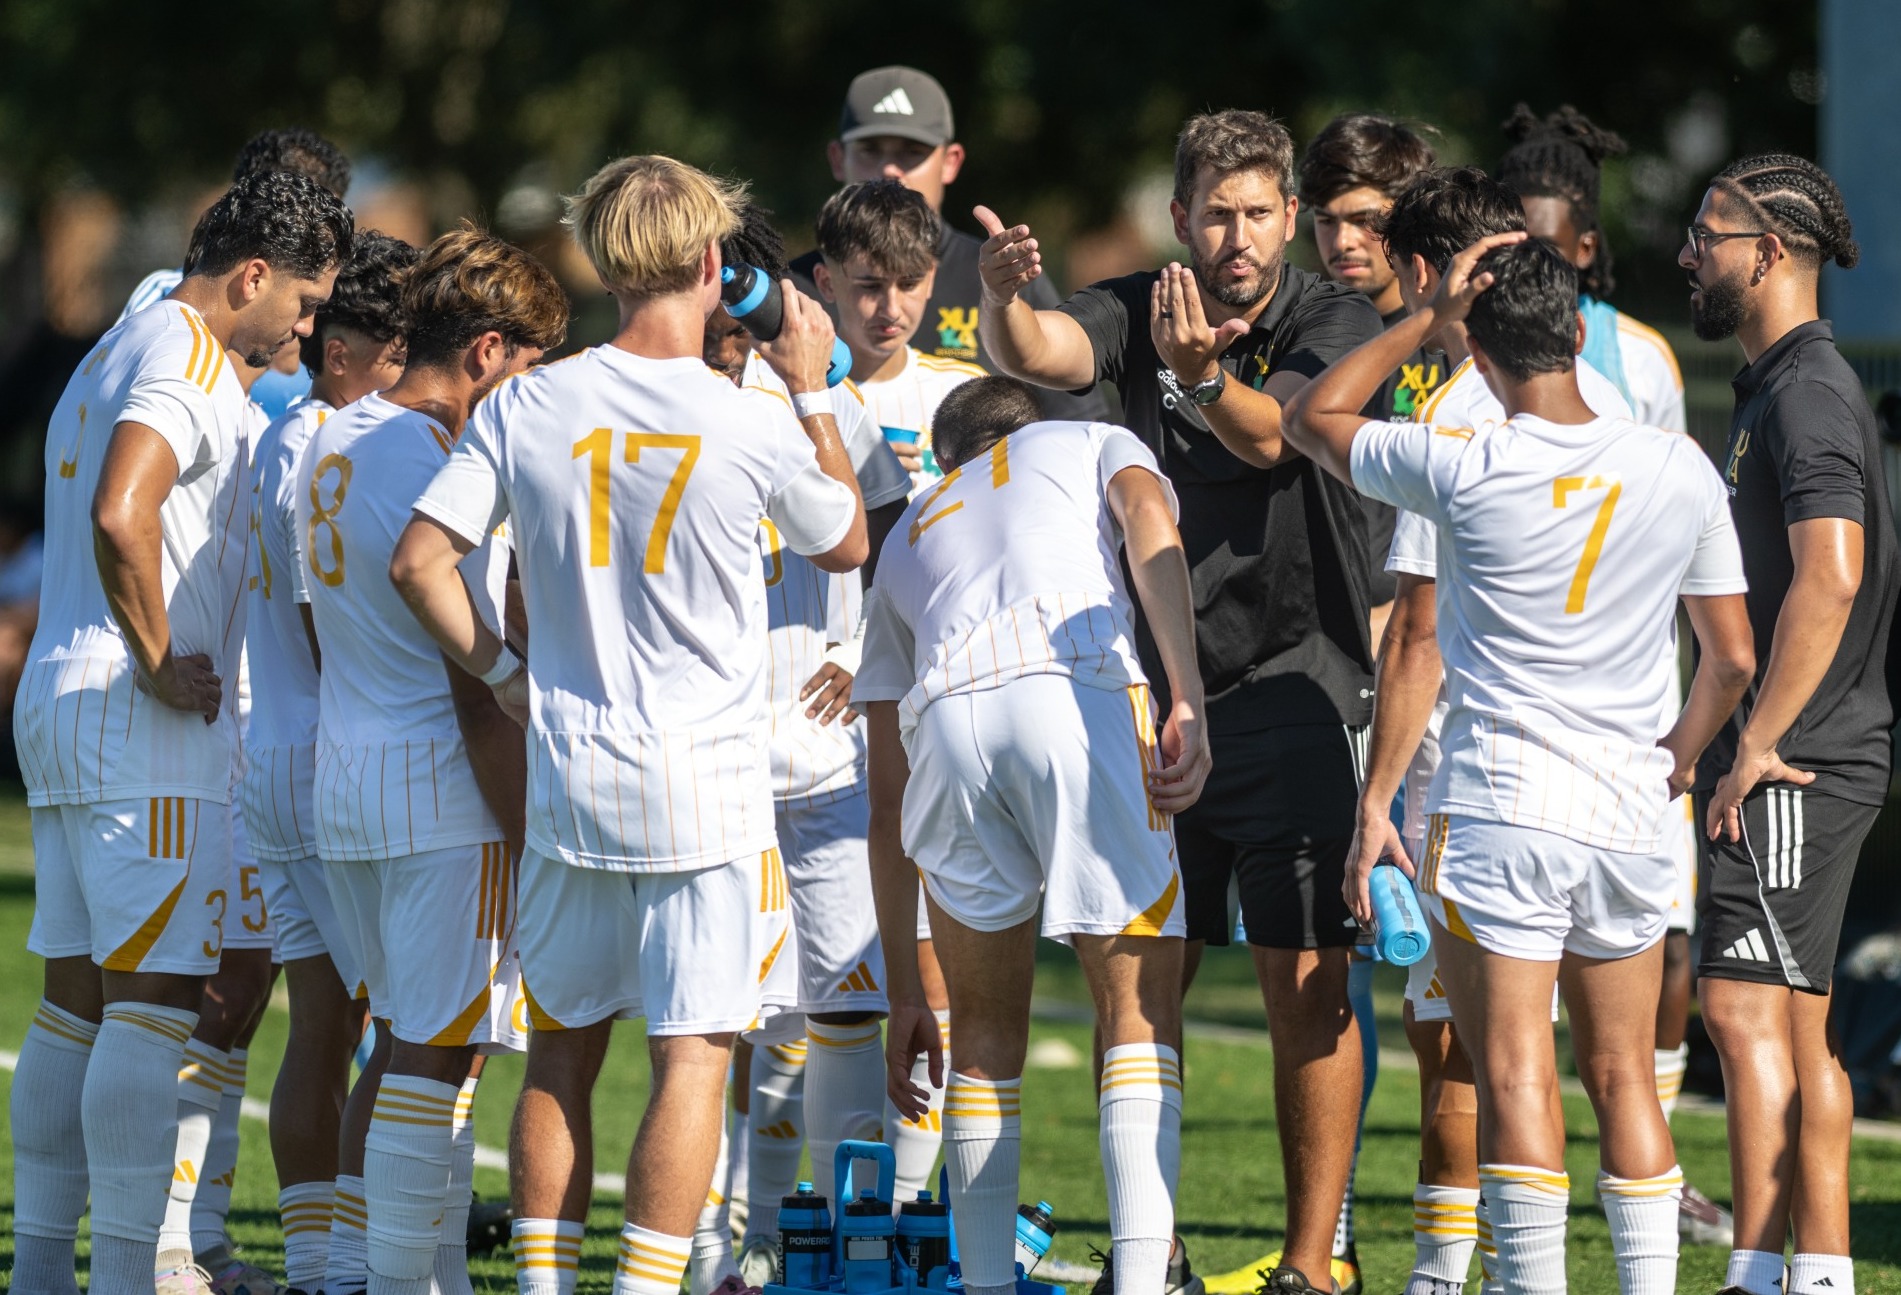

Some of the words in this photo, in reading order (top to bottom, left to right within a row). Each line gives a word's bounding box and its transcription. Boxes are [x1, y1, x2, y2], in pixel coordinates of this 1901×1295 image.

[1395, 363, 1439, 390] XU
[308, 453, 354, 587] 8
[572, 427, 702, 574] 17
[1553, 471, 1622, 614] 7
[203, 889, 228, 958] 3
[240, 866, 268, 933] 5
